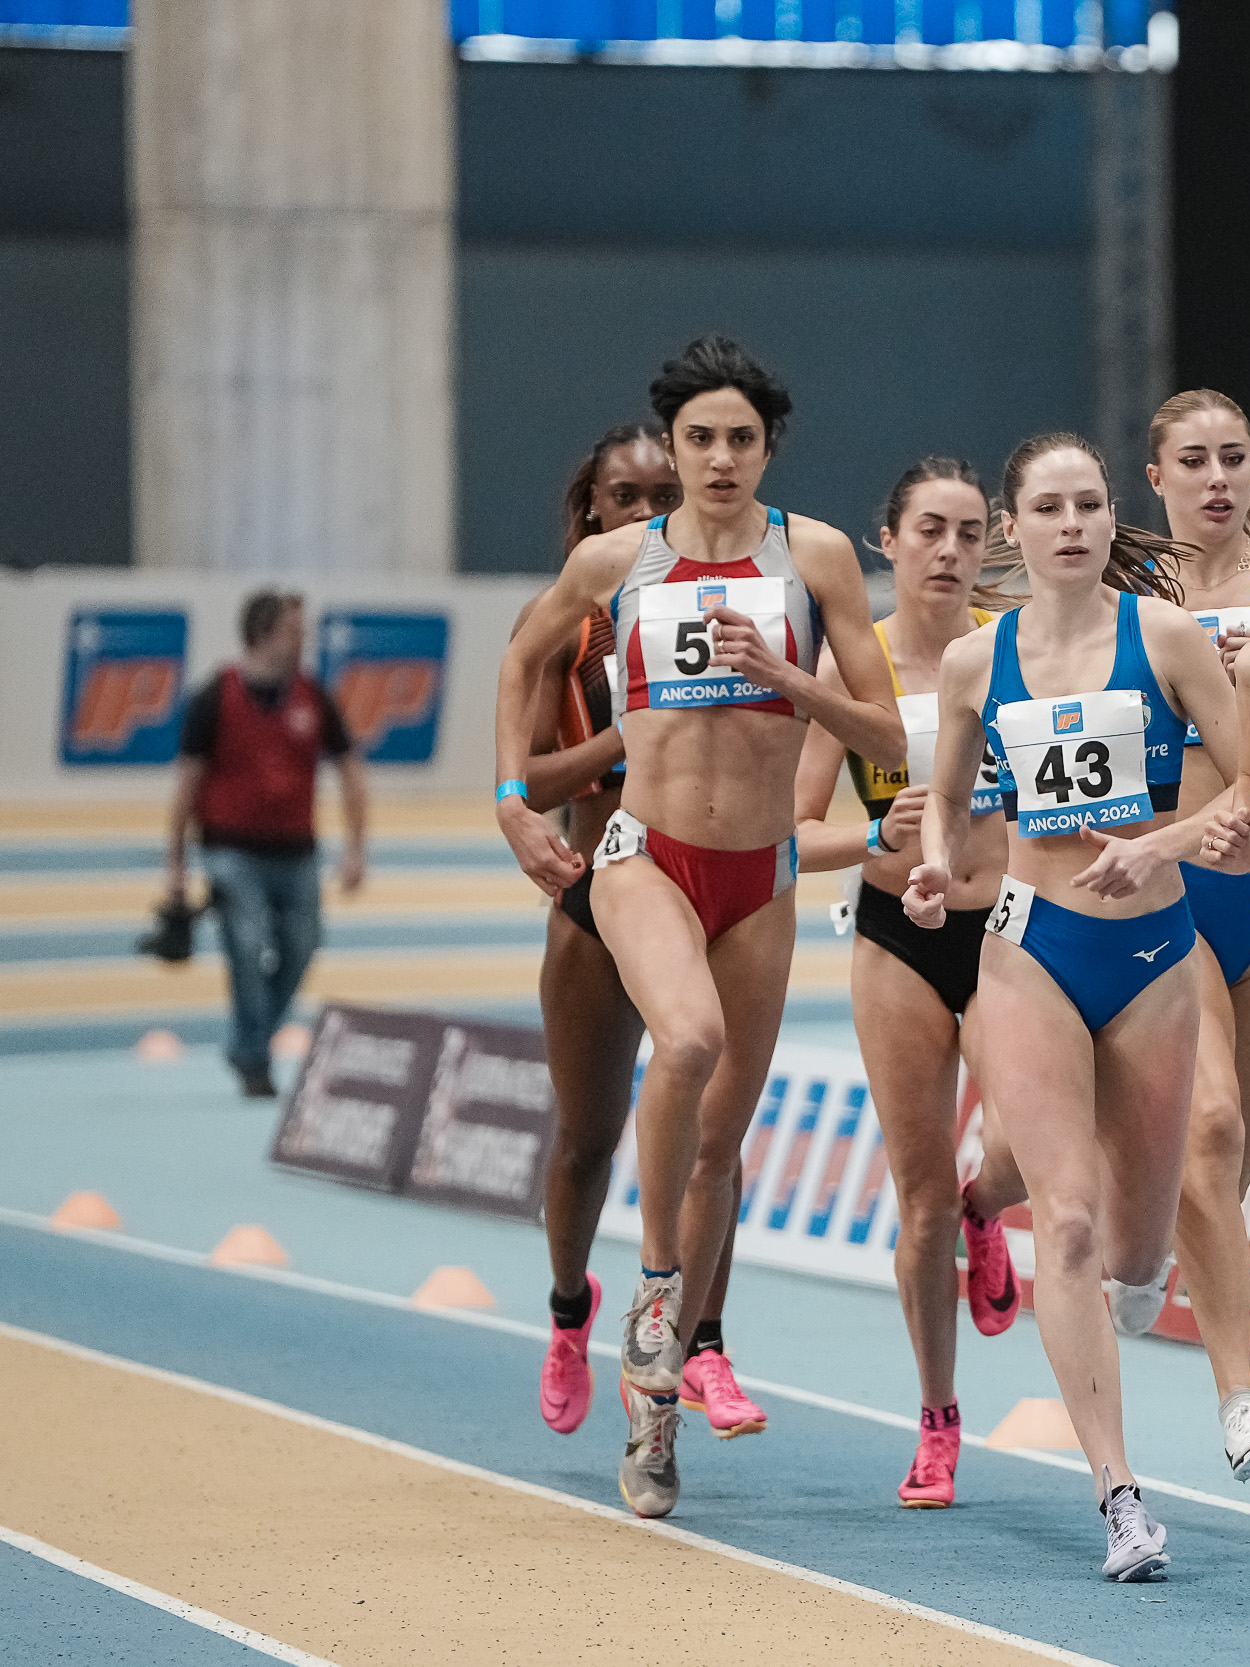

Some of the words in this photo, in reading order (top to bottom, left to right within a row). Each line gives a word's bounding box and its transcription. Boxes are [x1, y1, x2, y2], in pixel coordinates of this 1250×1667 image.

[659, 683, 730, 702] ANCONA
[1035, 740, 1112, 804] 43
[1027, 809, 1097, 832] ANCONA
[1099, 802, 1141, 823] 2024
[993, 891, 1015, 933] 5
